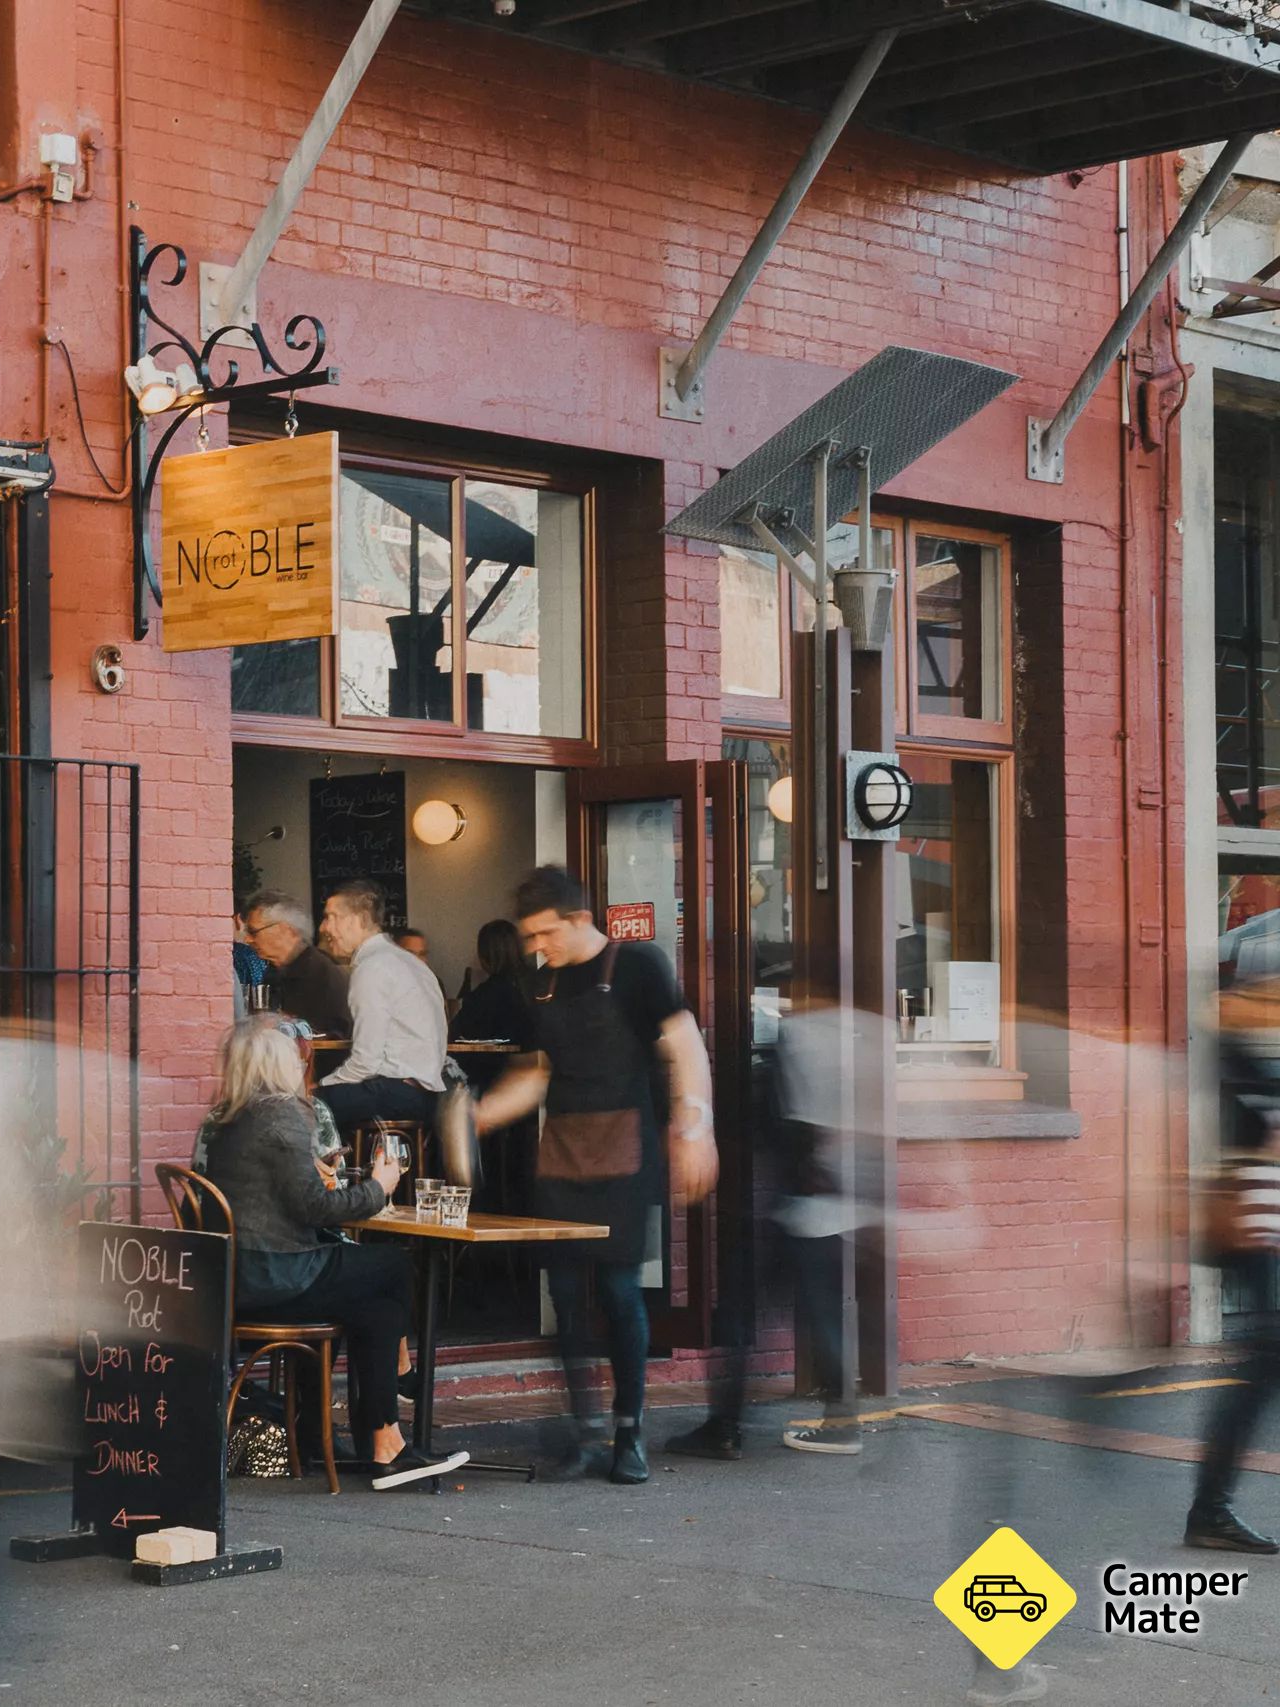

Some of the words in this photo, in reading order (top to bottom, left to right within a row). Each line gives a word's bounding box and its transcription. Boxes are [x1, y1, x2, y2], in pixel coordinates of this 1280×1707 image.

[178, 522, 315, 589] NOBLE
[212, 549, 236, 570] rot
[276, 573, 294, 583] wine
[296, 571, 308, 581] bar
[96, 645, 125, 693] 6
[611, 918, 650, 940] OPEN
[100, 1237, 194, 1291] NOBLE
[124, 1289, 162, 1333] Rot
[79, 1329, 131, 1381] Open
